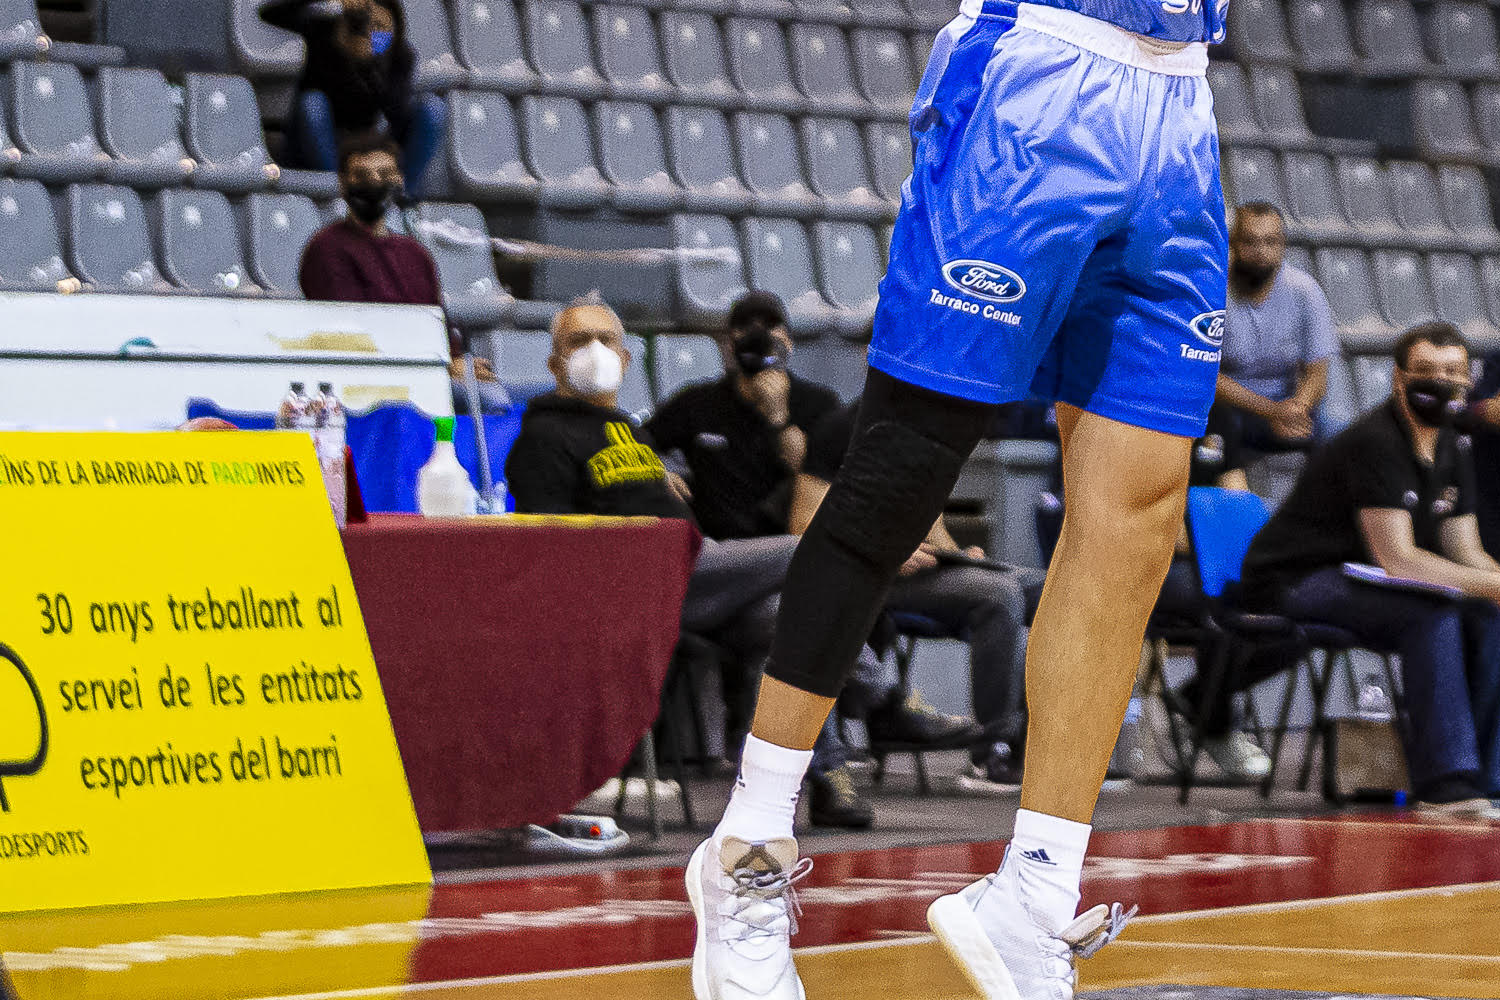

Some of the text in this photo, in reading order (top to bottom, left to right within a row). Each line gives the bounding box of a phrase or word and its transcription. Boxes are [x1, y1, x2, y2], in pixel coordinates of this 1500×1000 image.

[961, 266, 1011, 296] Ford
[930, 288, 1022, 326] Tarraco Center
[1180, 343, 1219, 362] Tarraco
[0, 453, 305, 487] ÏNS DE LA BARRIADA DE PARDINYES
[35, 585, 343, 643] 30 anys treballant al
[58, 660, 363, 713] servei de les entitats
[79, 734, 343, 799] esportives del barri
[0, 829, 91, 859] DESPORTS
